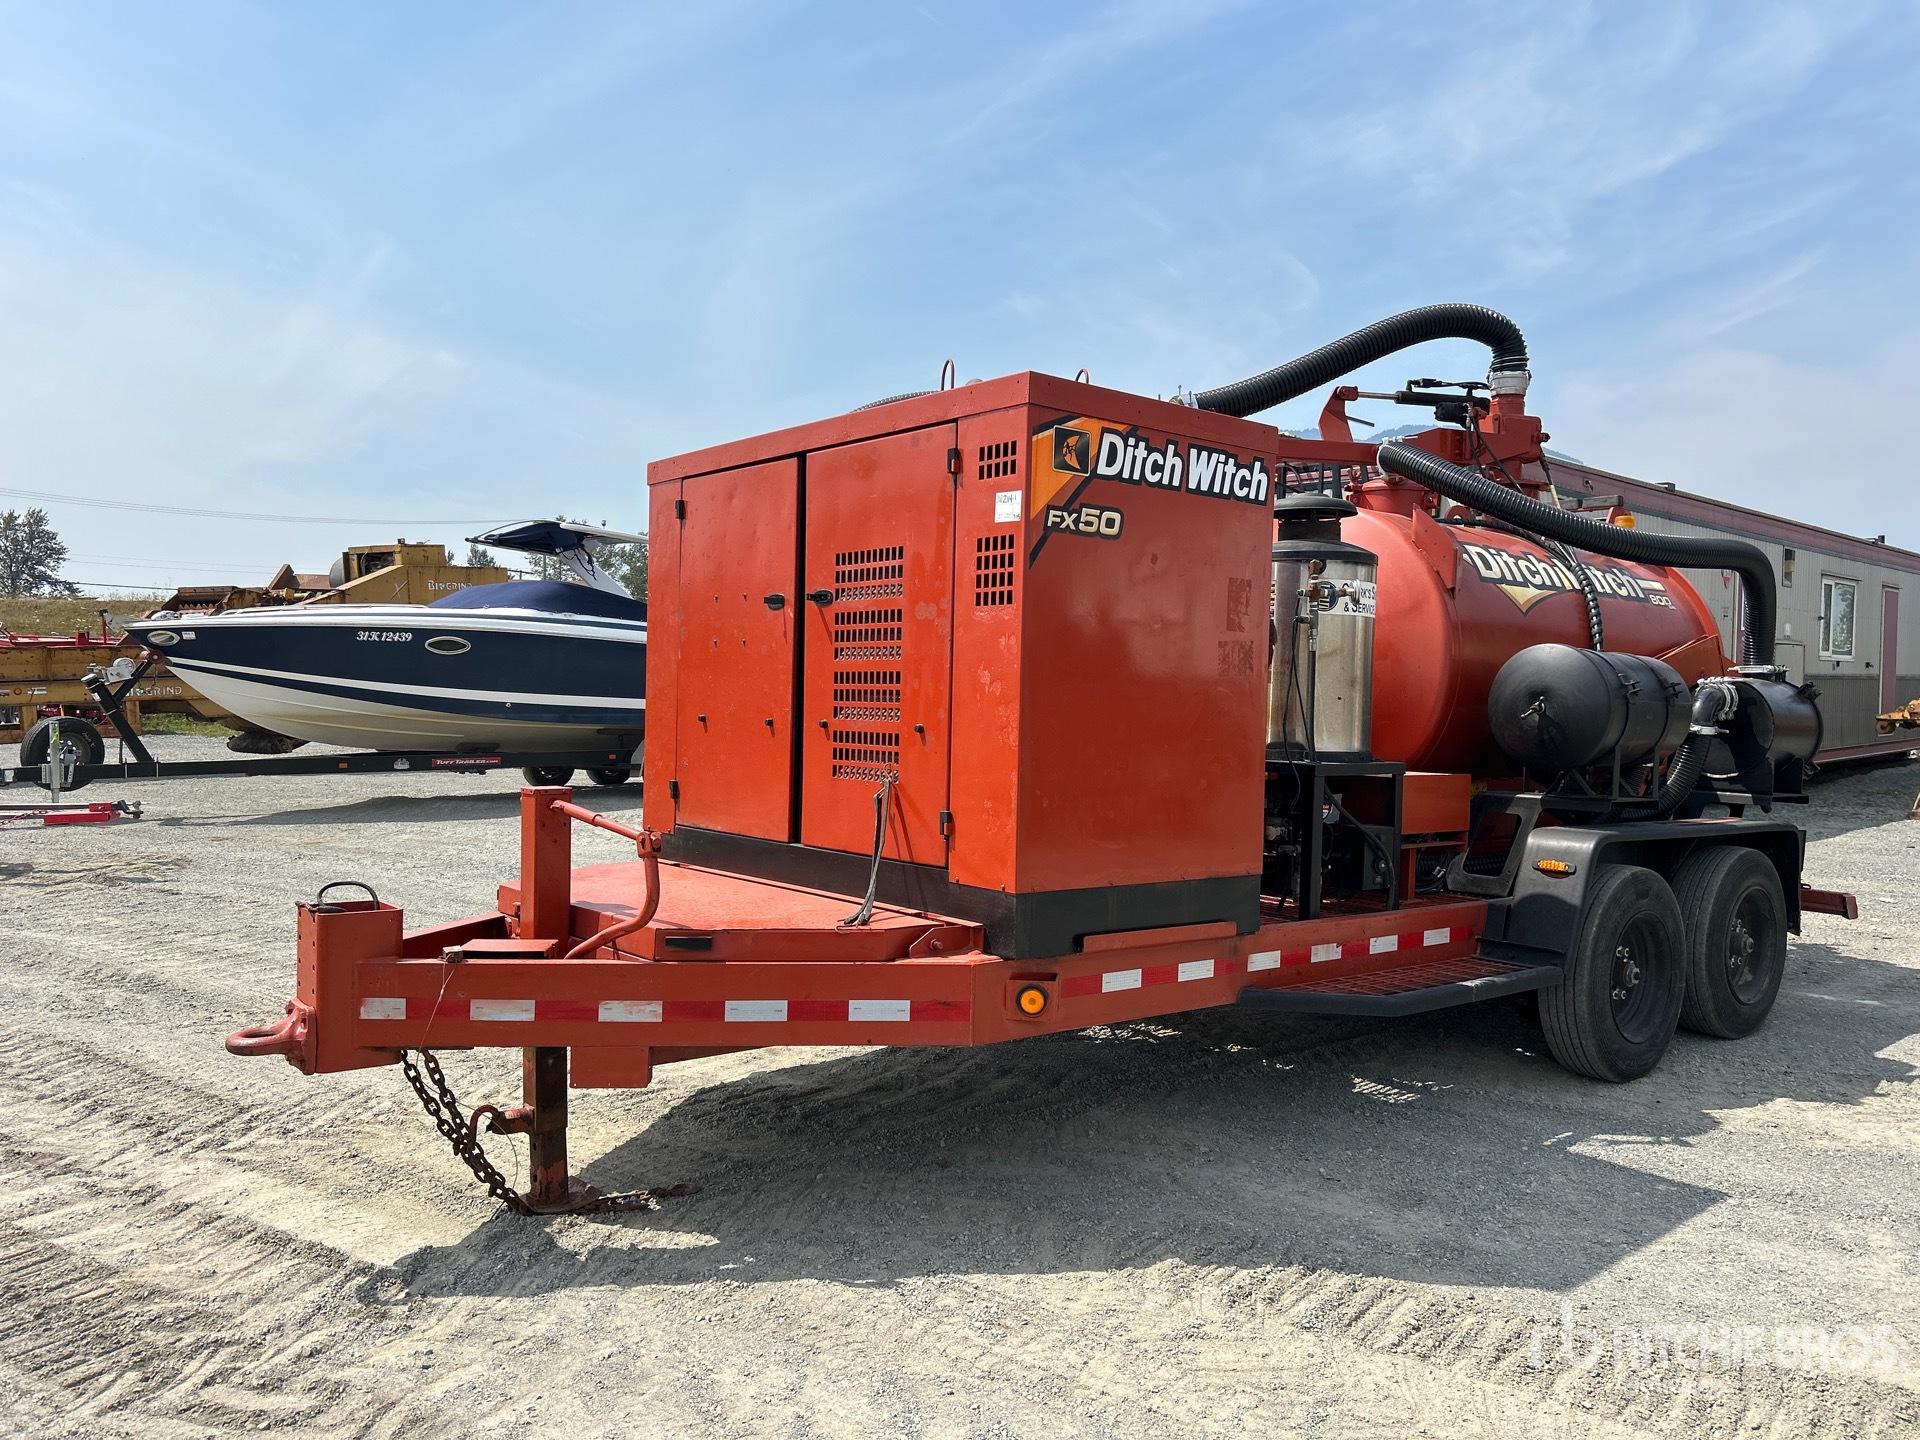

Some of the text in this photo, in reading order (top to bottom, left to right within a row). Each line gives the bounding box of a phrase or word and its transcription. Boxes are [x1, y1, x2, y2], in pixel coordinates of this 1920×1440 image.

[1096, 432, 1268, 501] Ditch Witch
[1047, 507, 1122, 536] FX50
[1463, 544, 1563, 588] Ditch
[1343, 601, 1350, 613] &
[1649, 594, 1672, 606] 800
[125, 686, 182, 697] IOGRIND
